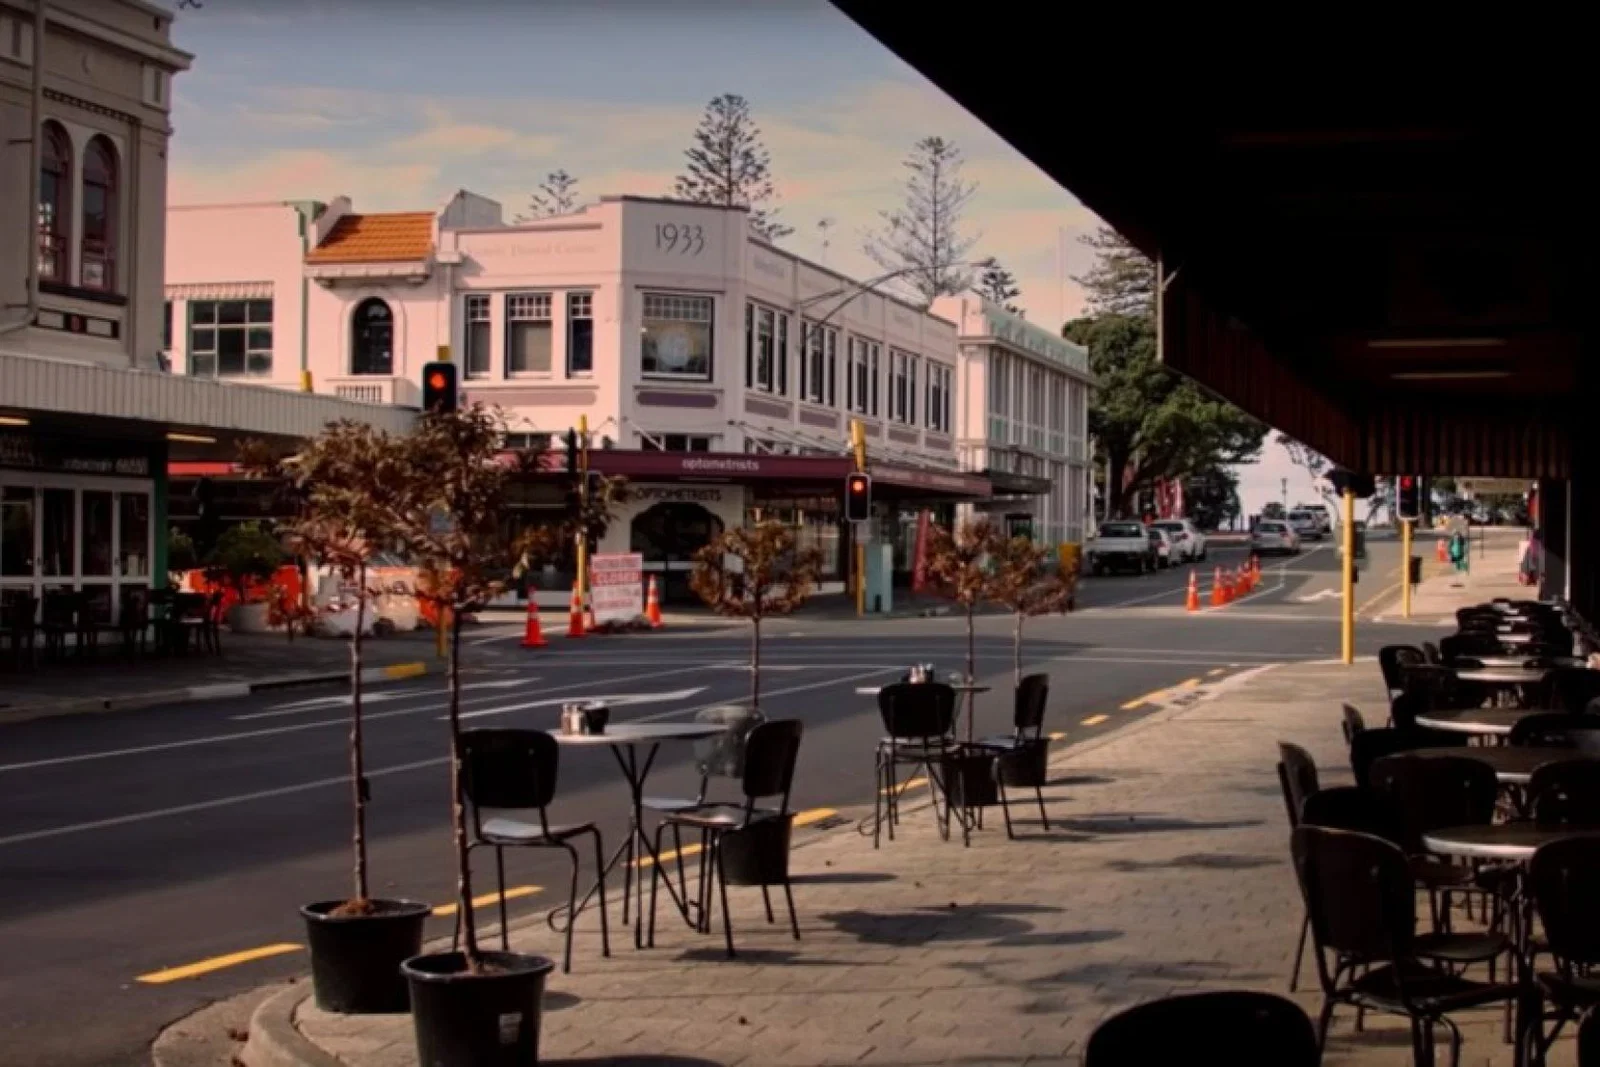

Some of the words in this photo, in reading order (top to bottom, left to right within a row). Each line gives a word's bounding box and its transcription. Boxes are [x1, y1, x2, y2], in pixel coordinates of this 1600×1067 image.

[655, 222, 705, 257] 1933
[681, 457, 760, 471] optometrists
[636, 487, 722, 501] OPTOMETRISTS
